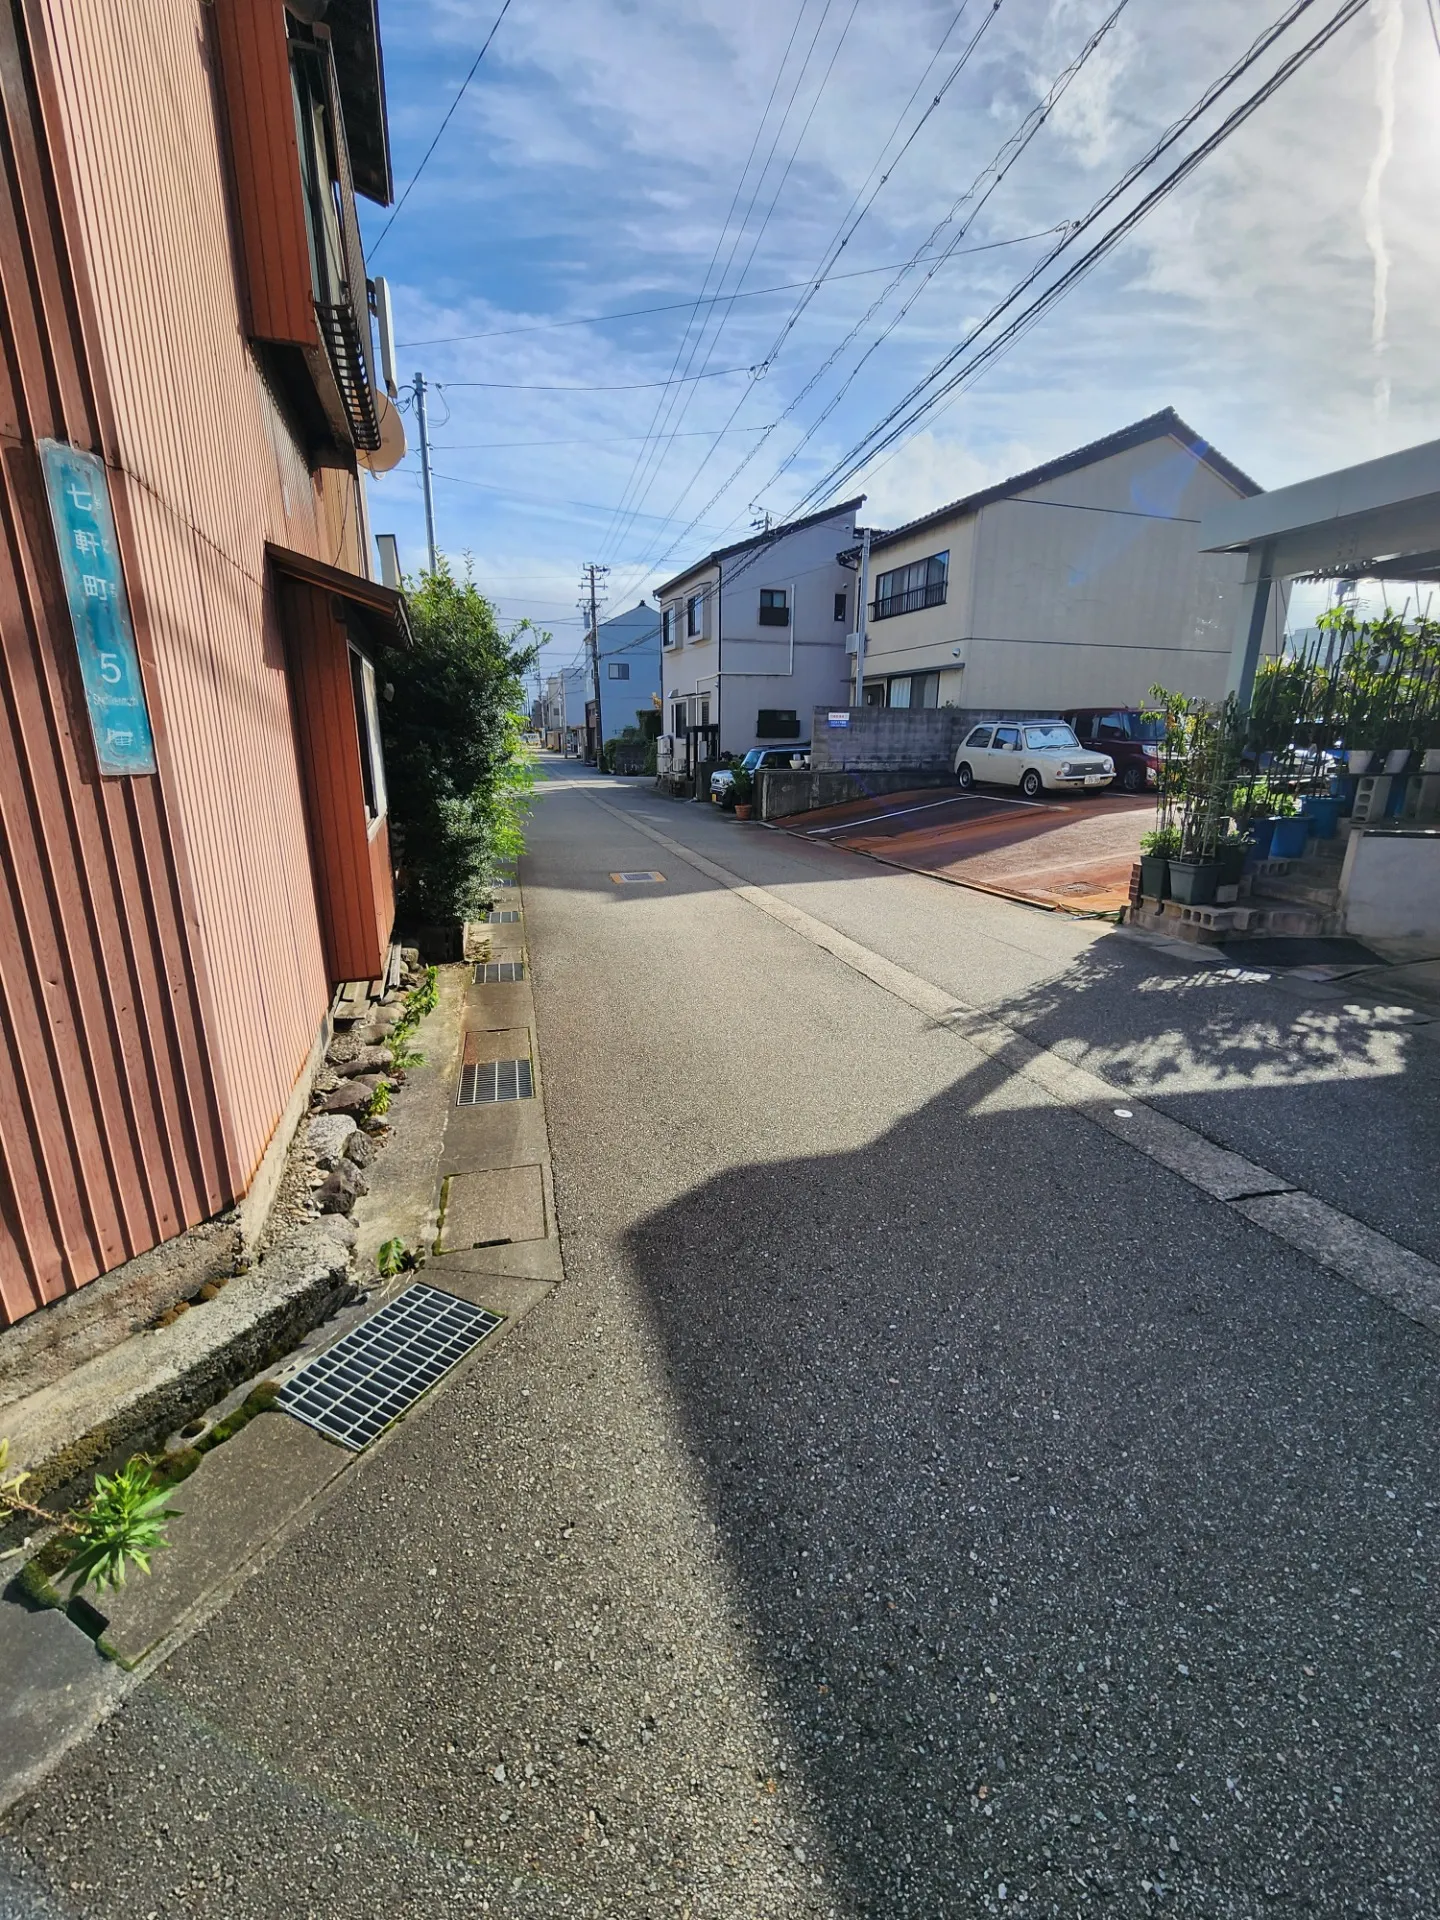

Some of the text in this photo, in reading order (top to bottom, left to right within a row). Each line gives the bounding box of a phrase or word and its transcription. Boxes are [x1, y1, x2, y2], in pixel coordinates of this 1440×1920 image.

[66, 483, 108, 600] 七軒町
[100, 652, 122, 684] 5
